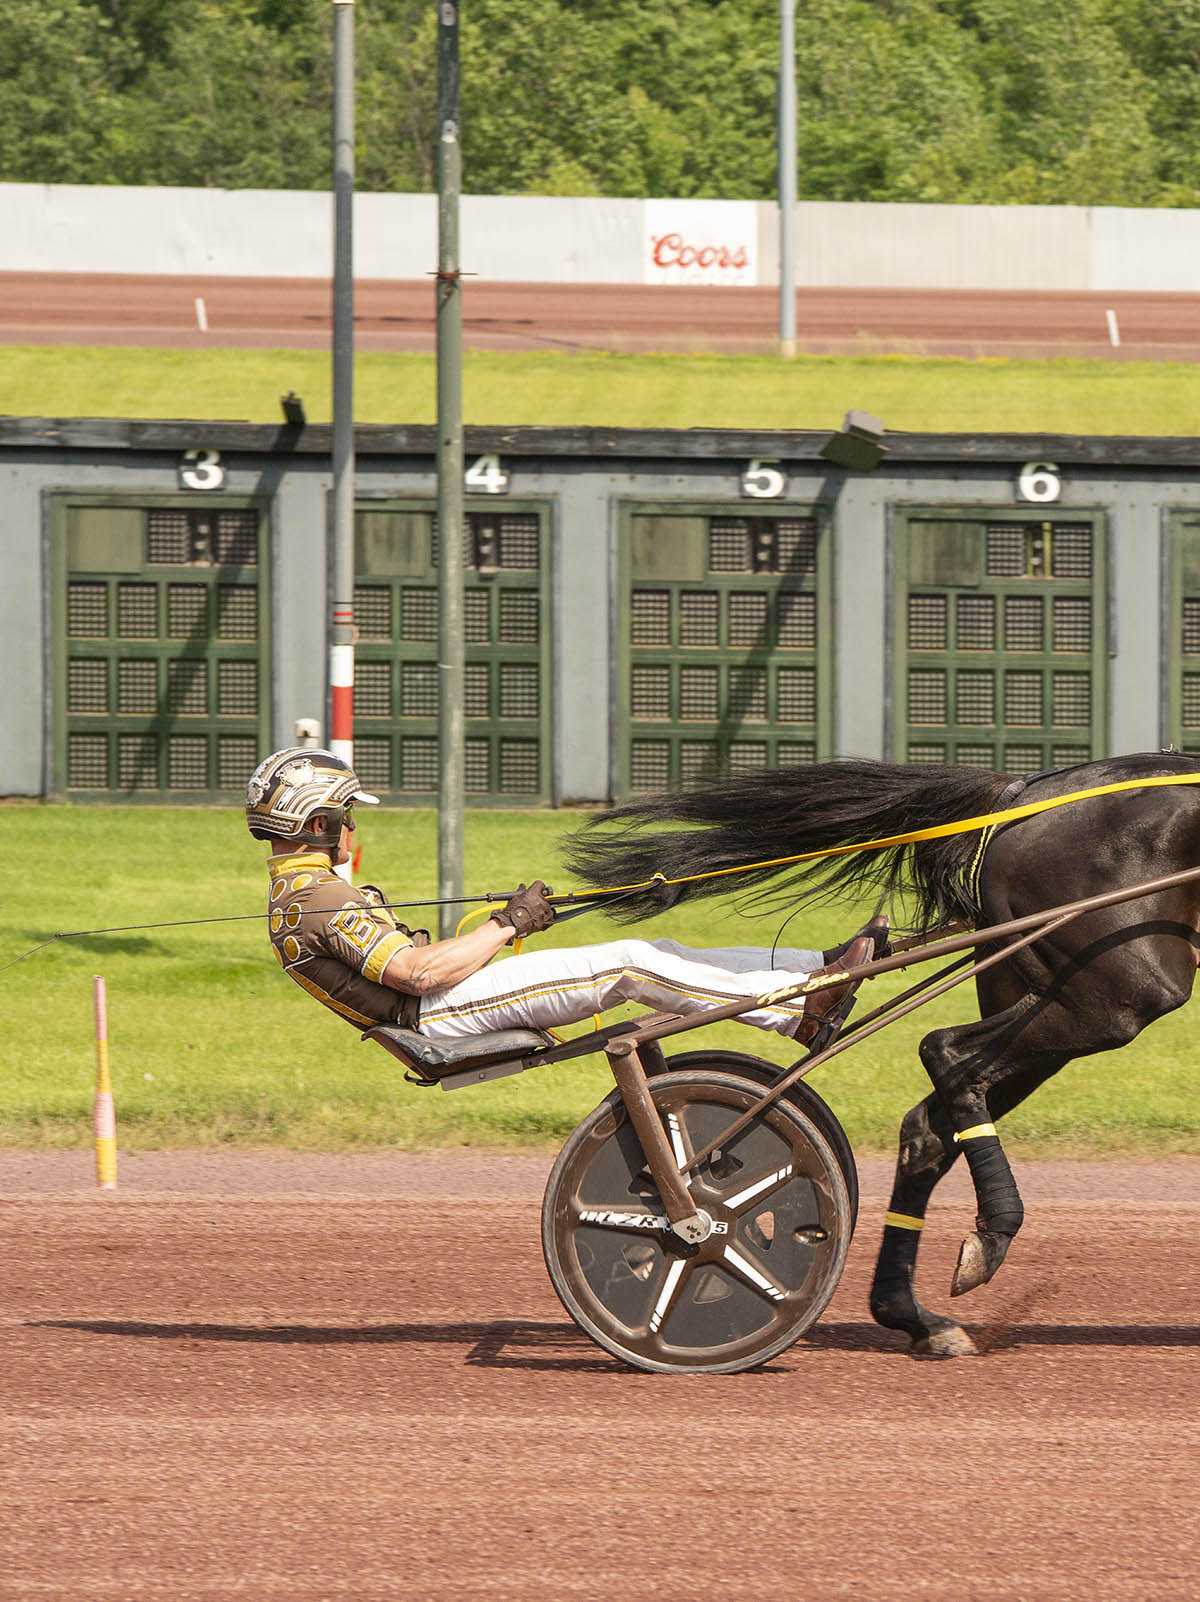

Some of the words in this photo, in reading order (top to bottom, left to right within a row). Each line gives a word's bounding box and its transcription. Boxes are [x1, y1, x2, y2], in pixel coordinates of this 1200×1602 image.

[651, 232, 748, 269] Coors
[182, 450, 223, 489] 3
[464, 454, 507, 494] 4
[744, 459, 784, 498] 5
[1020, 462, 1061, 503] 6
[327, 901, 381, 957] B
